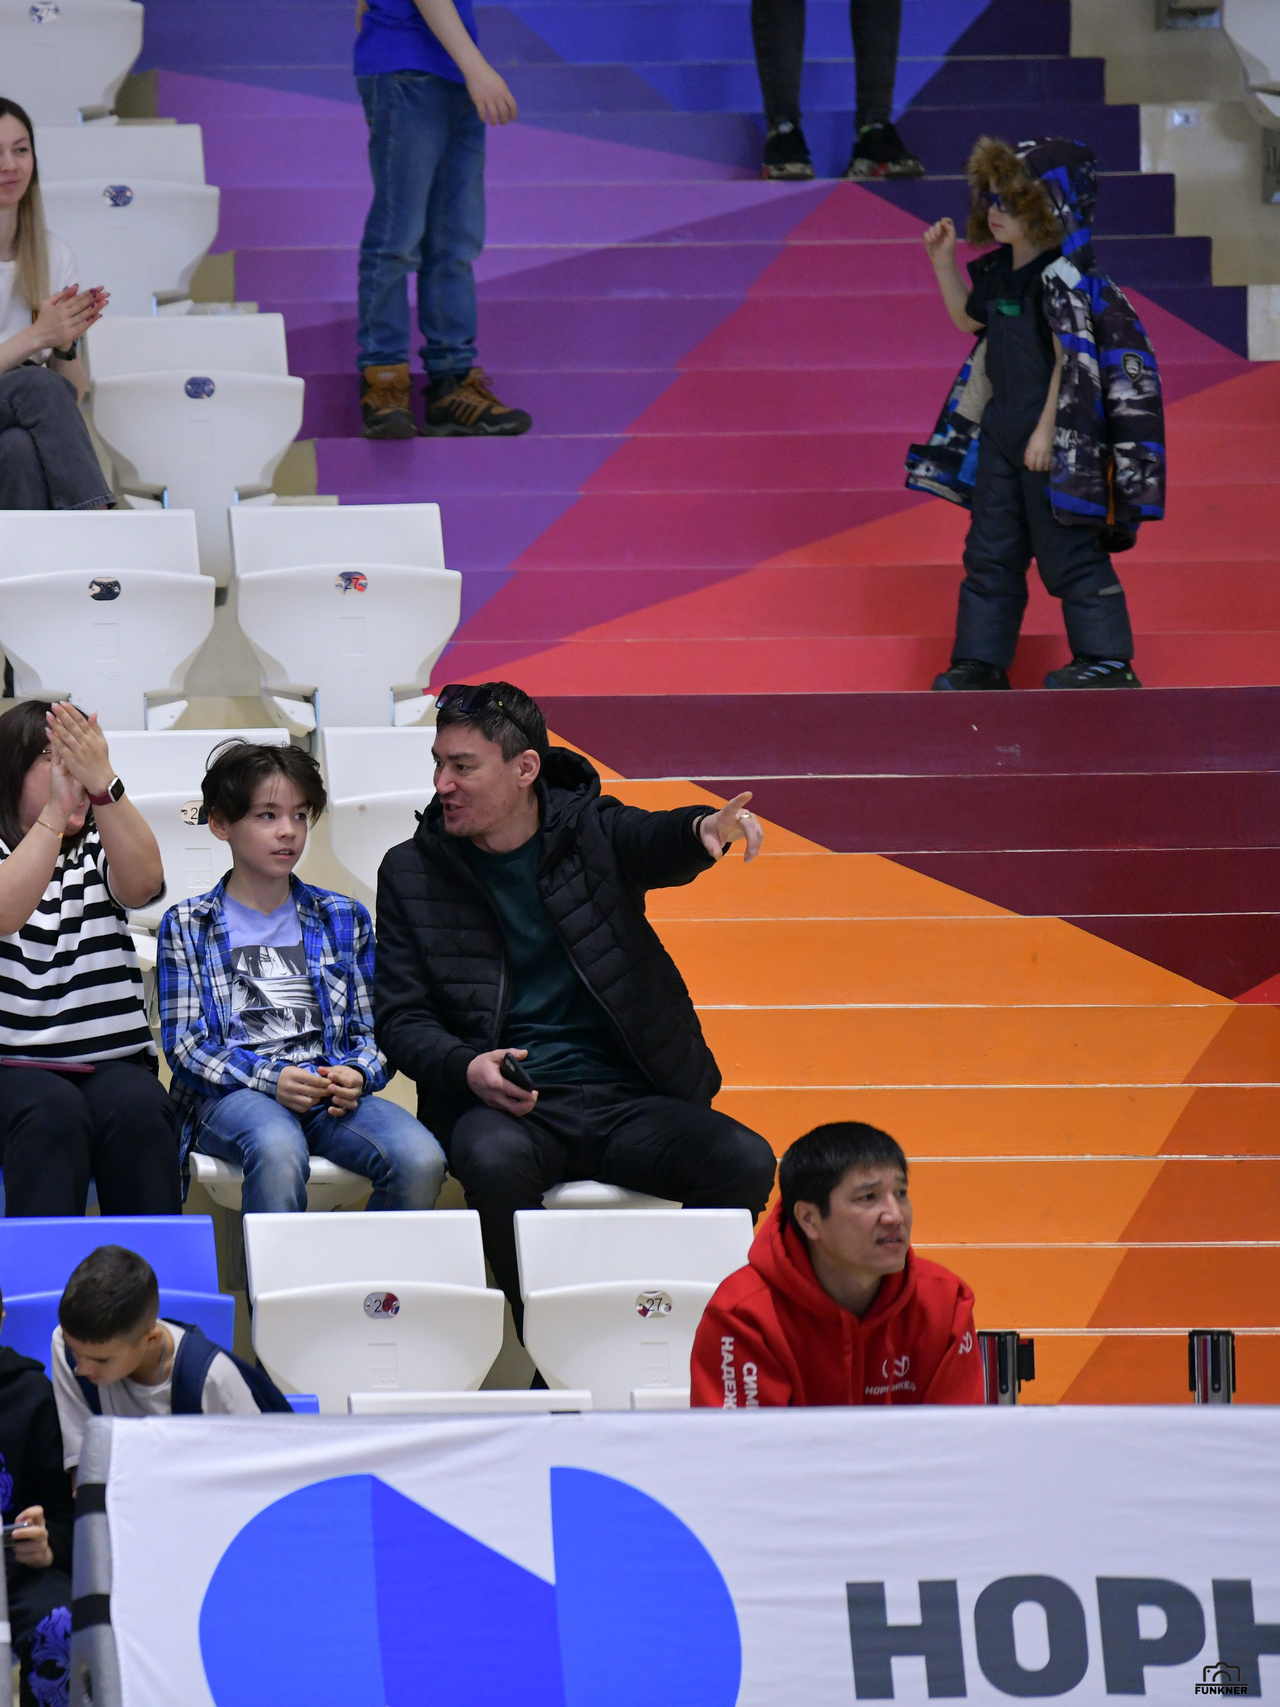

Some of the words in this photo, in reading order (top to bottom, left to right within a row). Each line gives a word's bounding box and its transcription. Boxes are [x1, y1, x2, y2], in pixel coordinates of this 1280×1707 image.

[373, 1299, 390, 1312] 26
[646, 1298, 663, 1312] 27
[742, 1362, 760, 1409] СИМ
